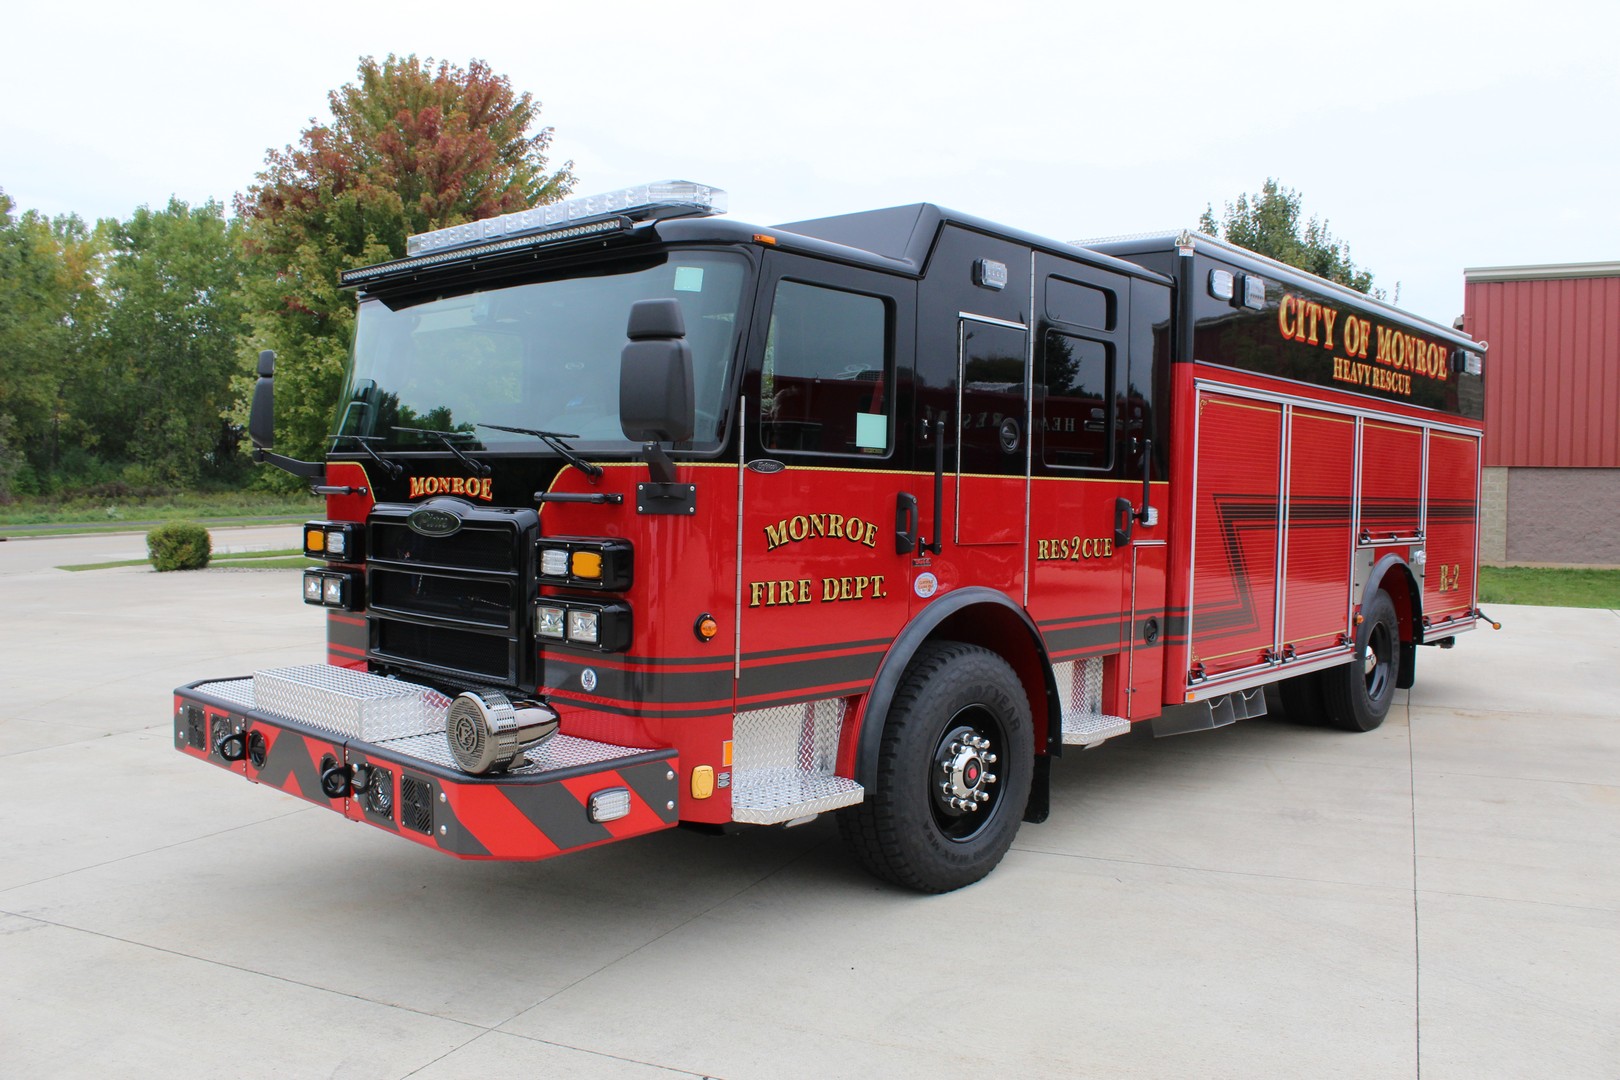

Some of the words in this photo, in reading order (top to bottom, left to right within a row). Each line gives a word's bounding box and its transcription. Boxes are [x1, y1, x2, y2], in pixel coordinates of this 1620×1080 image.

[1279, 294, 1338, 350] CITY
[1344, 314, 1371, 359] OF
[1376, 324, 1448, 381] MONROE
[1333, 357, 1372, 387] HEAVY
[1372, 366, 1412, 397] RESCUE
[409, 476, 493, 501] MONROE
[764, 513, 878, 551] MONROE
[1037, 535, 1112, 561] RES2CUE
[749, 579, 812, 607] FIRE
[821, 575, 887, 602] DEPT.
[1439, 563, 1460, 593] R-2
